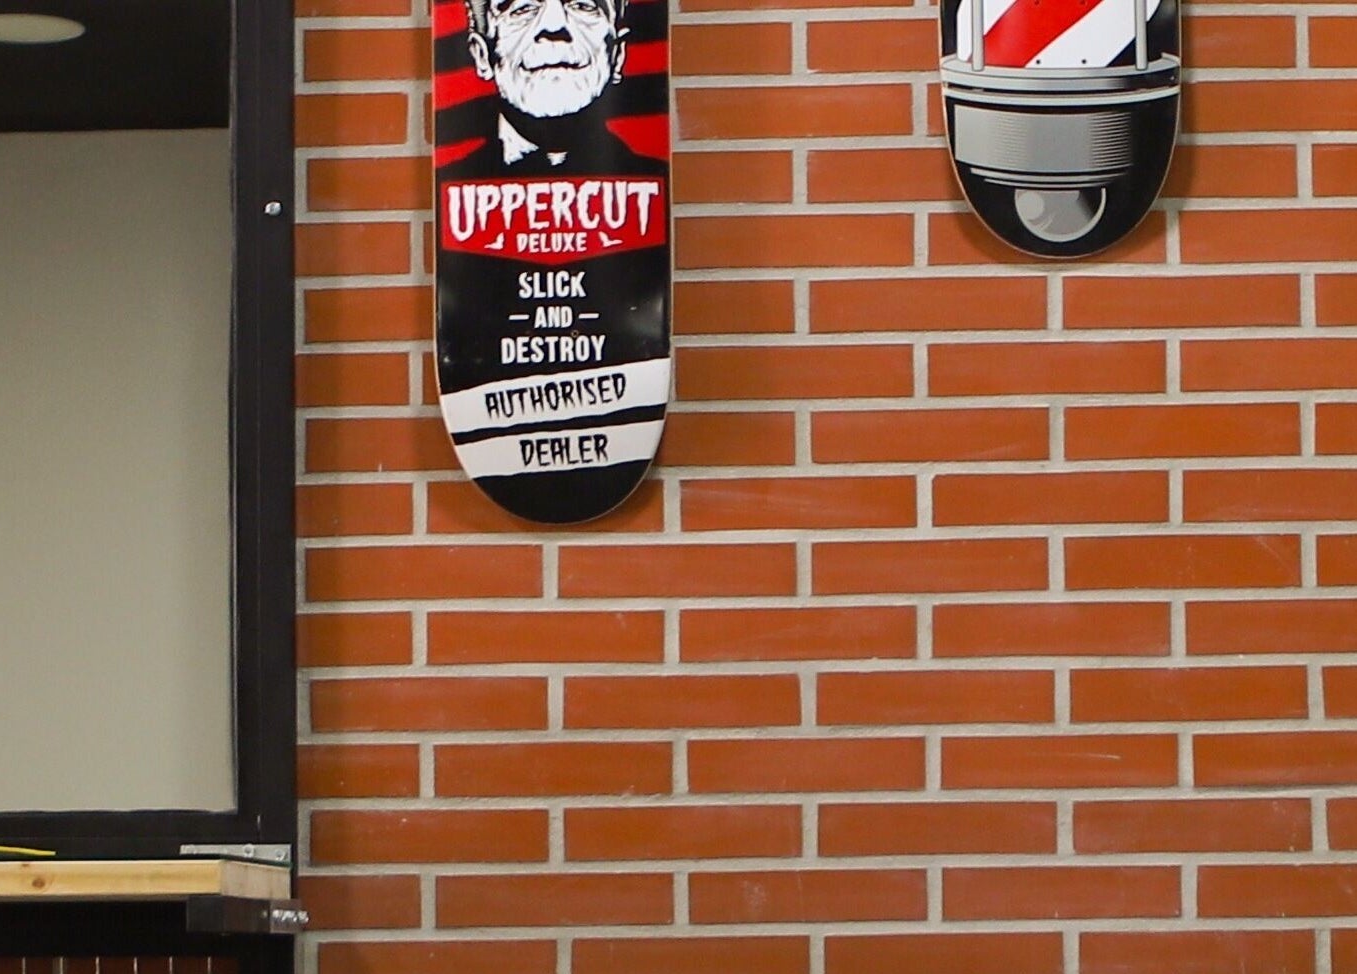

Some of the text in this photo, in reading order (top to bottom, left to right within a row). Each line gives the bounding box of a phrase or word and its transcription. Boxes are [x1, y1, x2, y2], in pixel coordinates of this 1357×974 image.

[447, 180, 660, 242] UPPERCUT
[516, 231, 588, 253] DELUXE
[518, 270, 587, 299] SLICK
[534, 305, 573, 329] AND
[500, 334, 606, 365] DESTROY
[484, 372, 627, 420] AUTHORISED
[519, 433, 609, 467] DEALER
